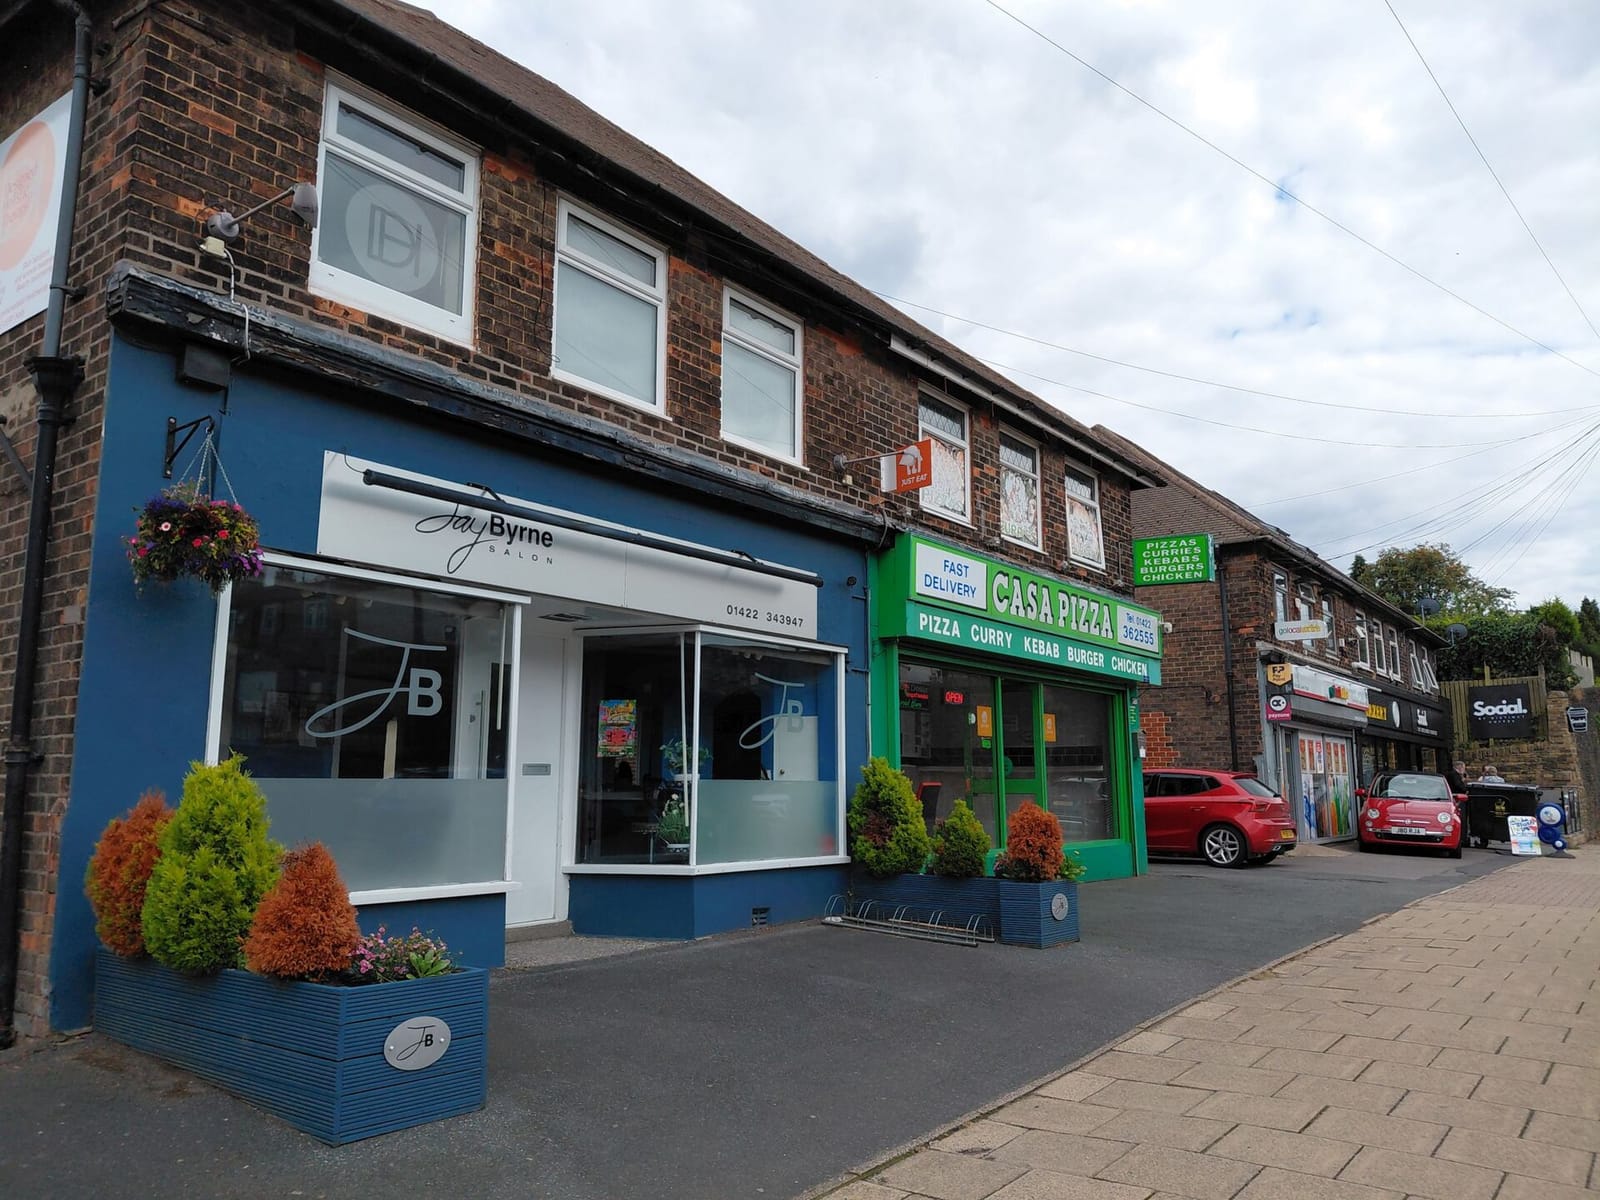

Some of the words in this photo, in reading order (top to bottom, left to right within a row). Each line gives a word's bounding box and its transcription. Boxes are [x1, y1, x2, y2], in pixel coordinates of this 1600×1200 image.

[901, 476, 915, 487] JUST
[916, 473, 928, 482] EAT
[489, 513, 554, 548] Byrne
[1142, 546, 1201, 558] CURRIES
[1146, 539, 1197, 550] PIZZAS
[489, 545, 554, 565] SALON
[1144, 555, 1200, 566] KEBABS
[943, 559, 970, 578] FAST
[1140, 563, 1204, 574] BURGERS
[1142, 571, 1202, 582] CHICKEN
[924, 574, 977, 598] DELIVERY
[992, 571, 1054, 625] CASA
[1058, 589, 1114, 640] PIZZA
[726, 604, 759, 620] 01422
[766, 612, 804, 628] 343947
[1136, 616, 1152, 629] 01422
[919, 612, 960, 638] PIZZA
[971, 624, 1013, 649] CURRY
[1023, 636, 1060, 659] KEBAB
[1067, 646, 1105, 668] BURGER
[1111, 656, 1148, 677] CHICKEN
[1123, 625, 1154, 645] 362555
[945, 691, 963, 705] OPEN
[395, 1024, 437, 1061] JB
